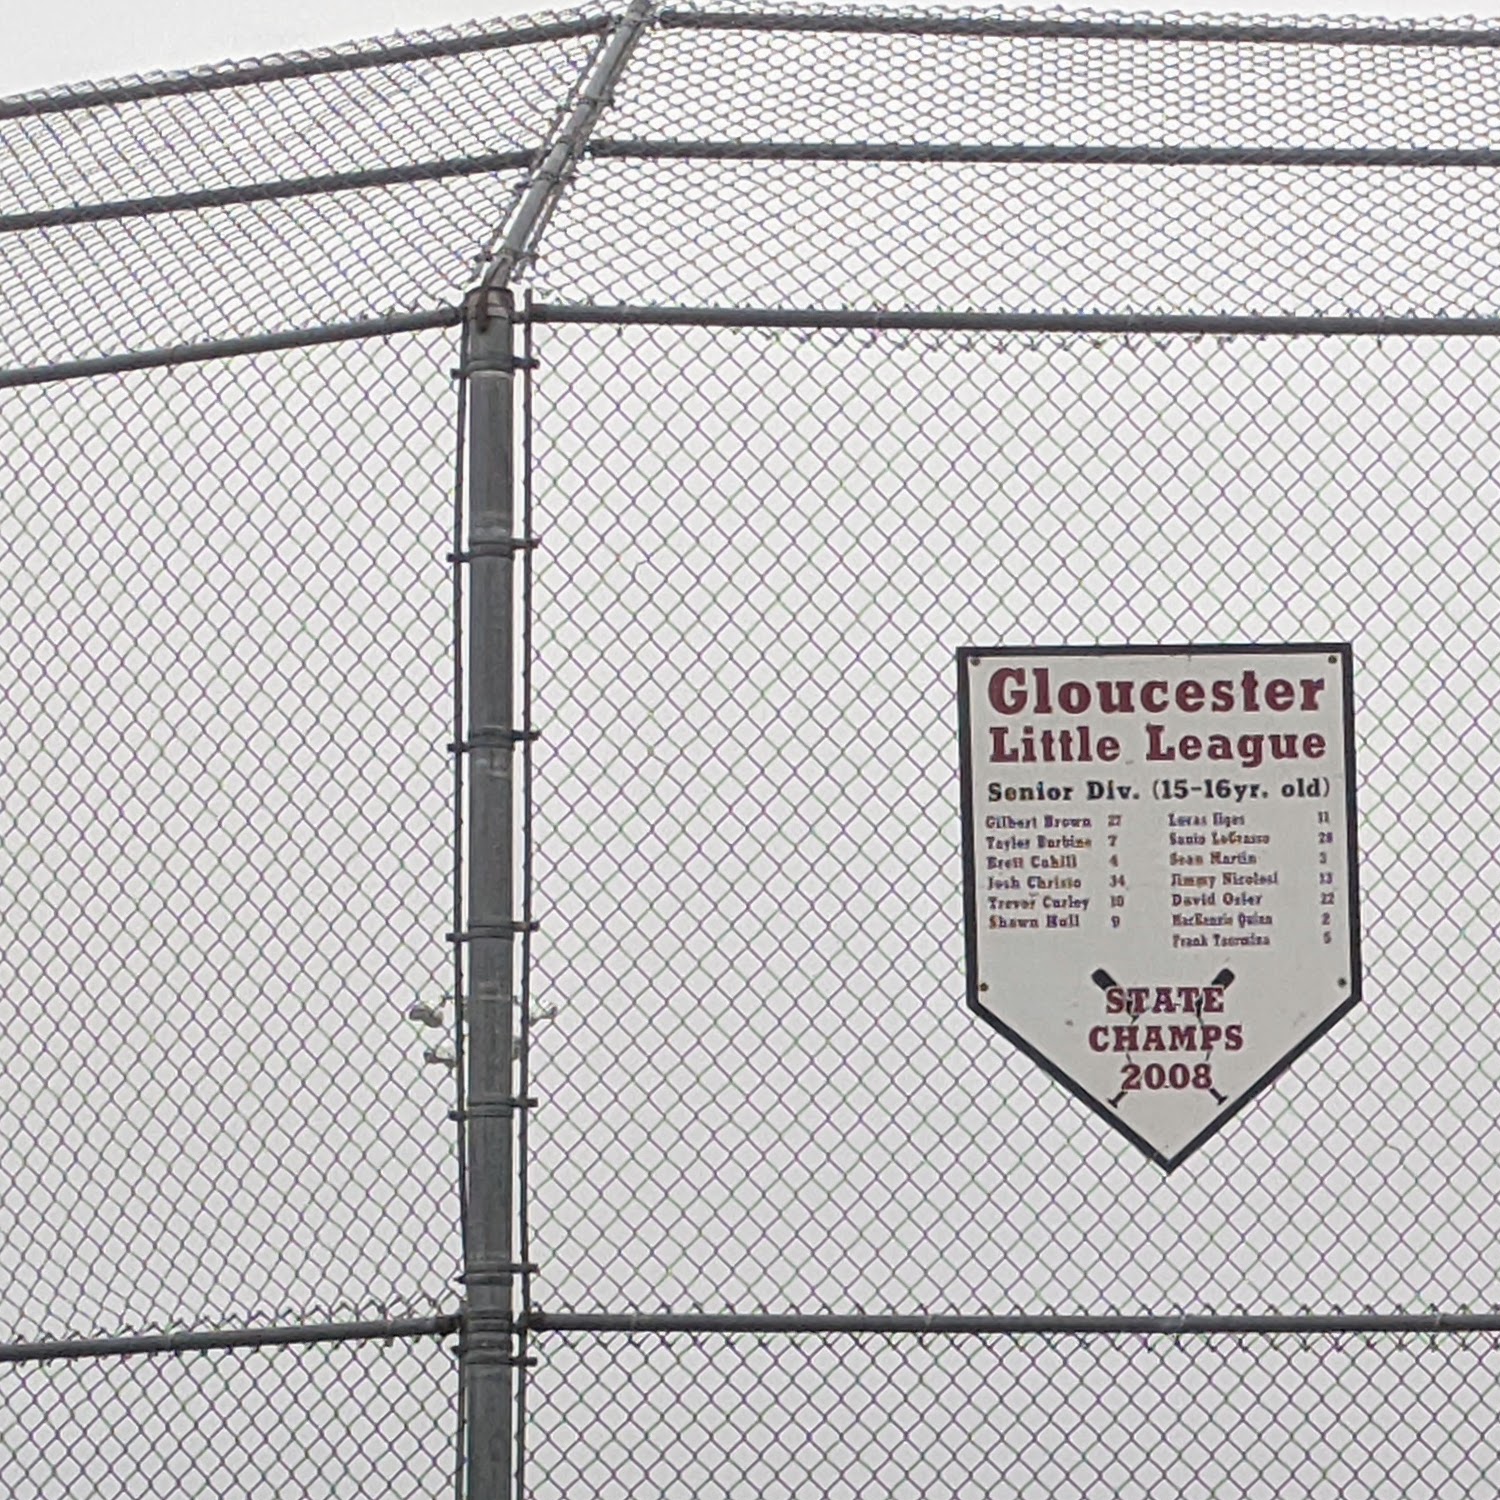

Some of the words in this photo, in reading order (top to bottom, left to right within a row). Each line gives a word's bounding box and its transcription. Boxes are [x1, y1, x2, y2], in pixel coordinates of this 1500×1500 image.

[988, 667, 1325, 715] Gloucester
[989, 726, 1120, 764] Little
[1145, 722, 1326, 768] League
[988, 781, 1073, 803] Senior
[1086, 780, 1140, 801] Div.
[1152, 778, 1269, 804] (15-16yr.
[1281, 776, 1331, 799] old)
[985, 815, 1037, 829] Gilbert
[1044, 815, 1092, 828] Brown
[1108, 835, 1118, 847] 7
[986, 856, 1024, 869] Brett
[1030, 854, 1077, 868] Cahill
[1210, 851, 1257, 864] Martin
[988, 876, 1020, 890] Josh
[1171, 873, 1216, 888] Jimmy
[988, 895, 1035, 910] Trevor
[1171, 892, 1216, 907] David
[989, 915, 1039, 929] Shawn
[1173, 934, 1208, 948] Frank
[1106, 987, 1225, 1014] STATE
[1088, 1025, 1243, 1052] CHAMPS
[1120, 1063, 1212, 1090] 2008
